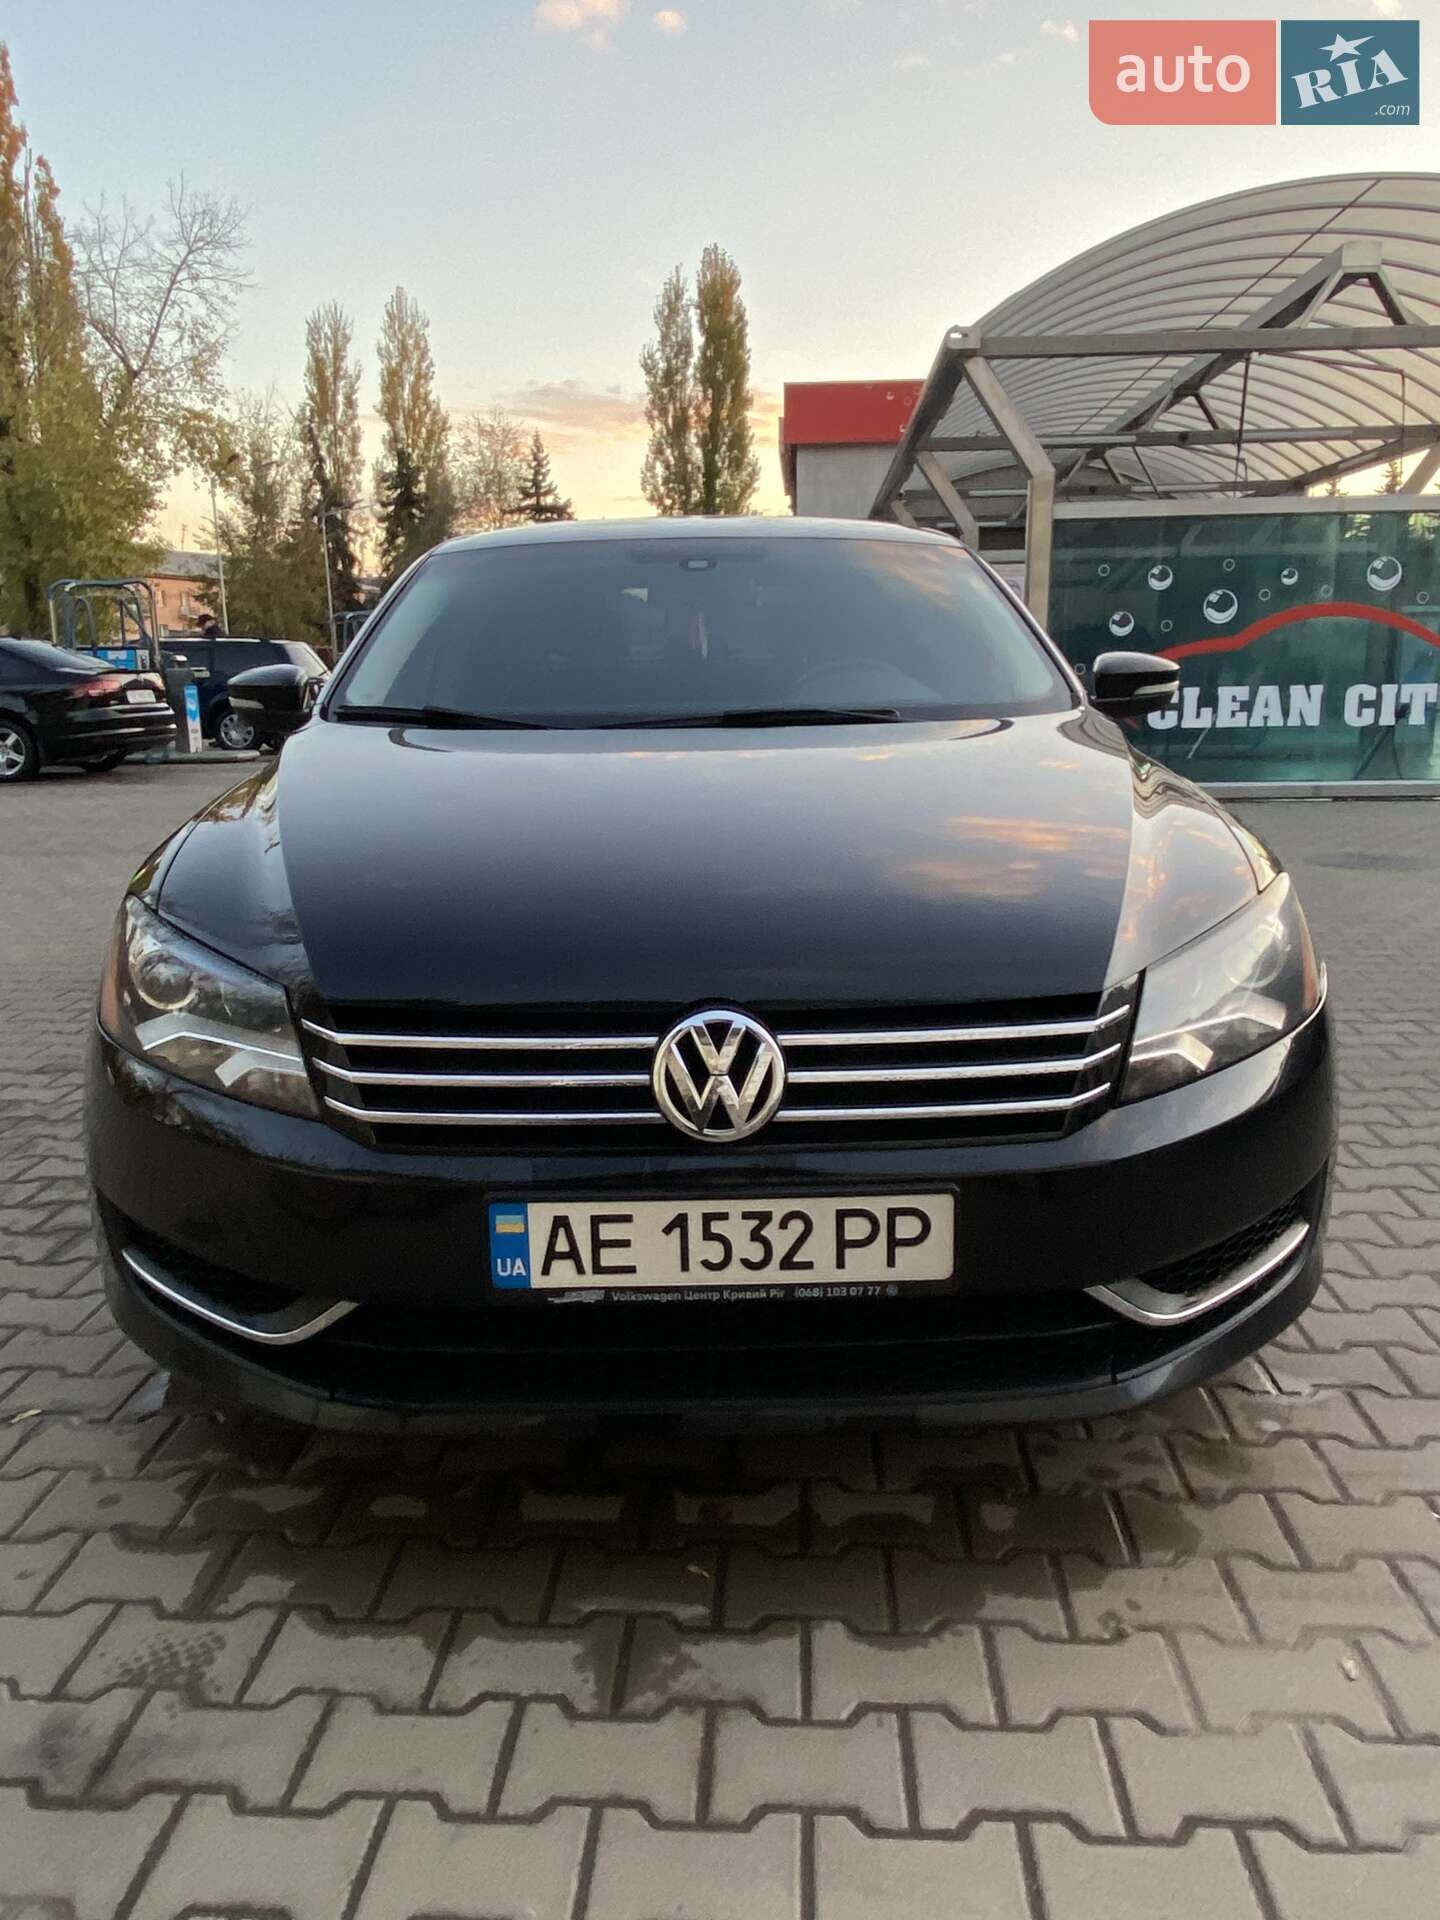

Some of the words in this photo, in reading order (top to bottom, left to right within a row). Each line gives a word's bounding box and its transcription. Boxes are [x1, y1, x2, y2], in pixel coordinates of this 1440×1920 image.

[540, 1213, 637, 1277] AE
[661, 1210, 815, 1273] 1532
[835, 1206, 933, 1270] PP
[496, 1257, 527, 1277] UA
[611, 1291, 681, 1303] Volkswagen
[684, 1290, 720, 1302] Центр
[826, 1286, 847, 1297] 103
[849, 1286, 864, 1297] 07
[867, 1285, 881, 1296] 77
